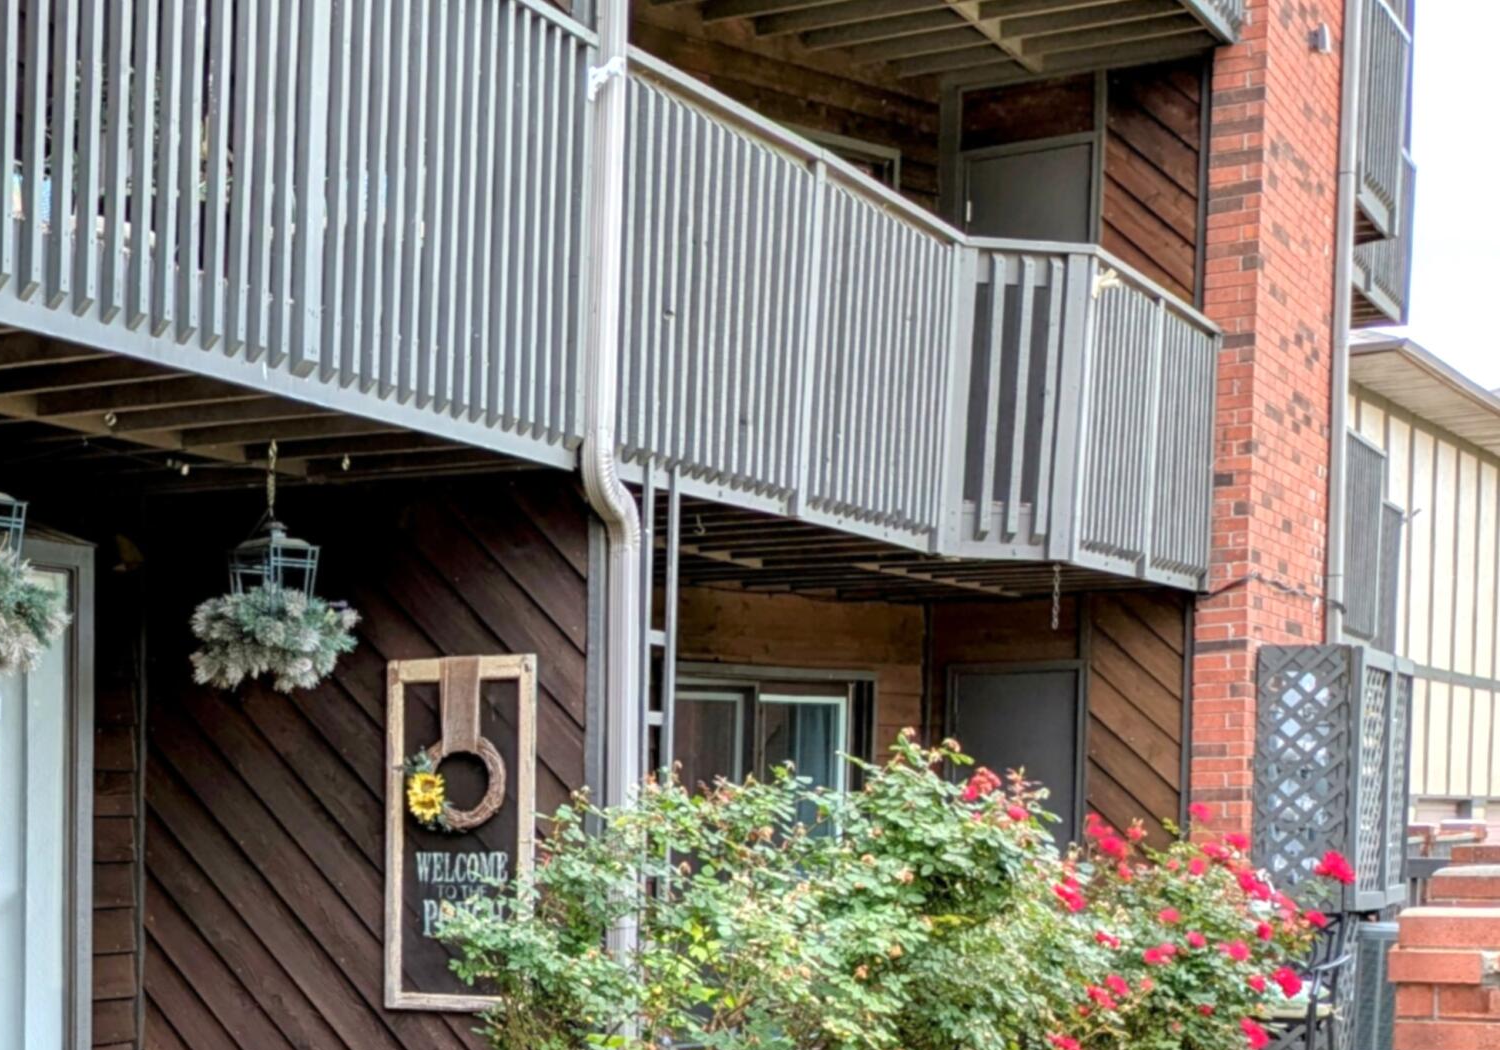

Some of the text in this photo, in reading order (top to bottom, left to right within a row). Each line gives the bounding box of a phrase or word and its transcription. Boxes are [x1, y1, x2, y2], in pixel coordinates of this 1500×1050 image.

[415, 852, 509, 884] WELCOME
[437, 884, 489, 901] TO THE
